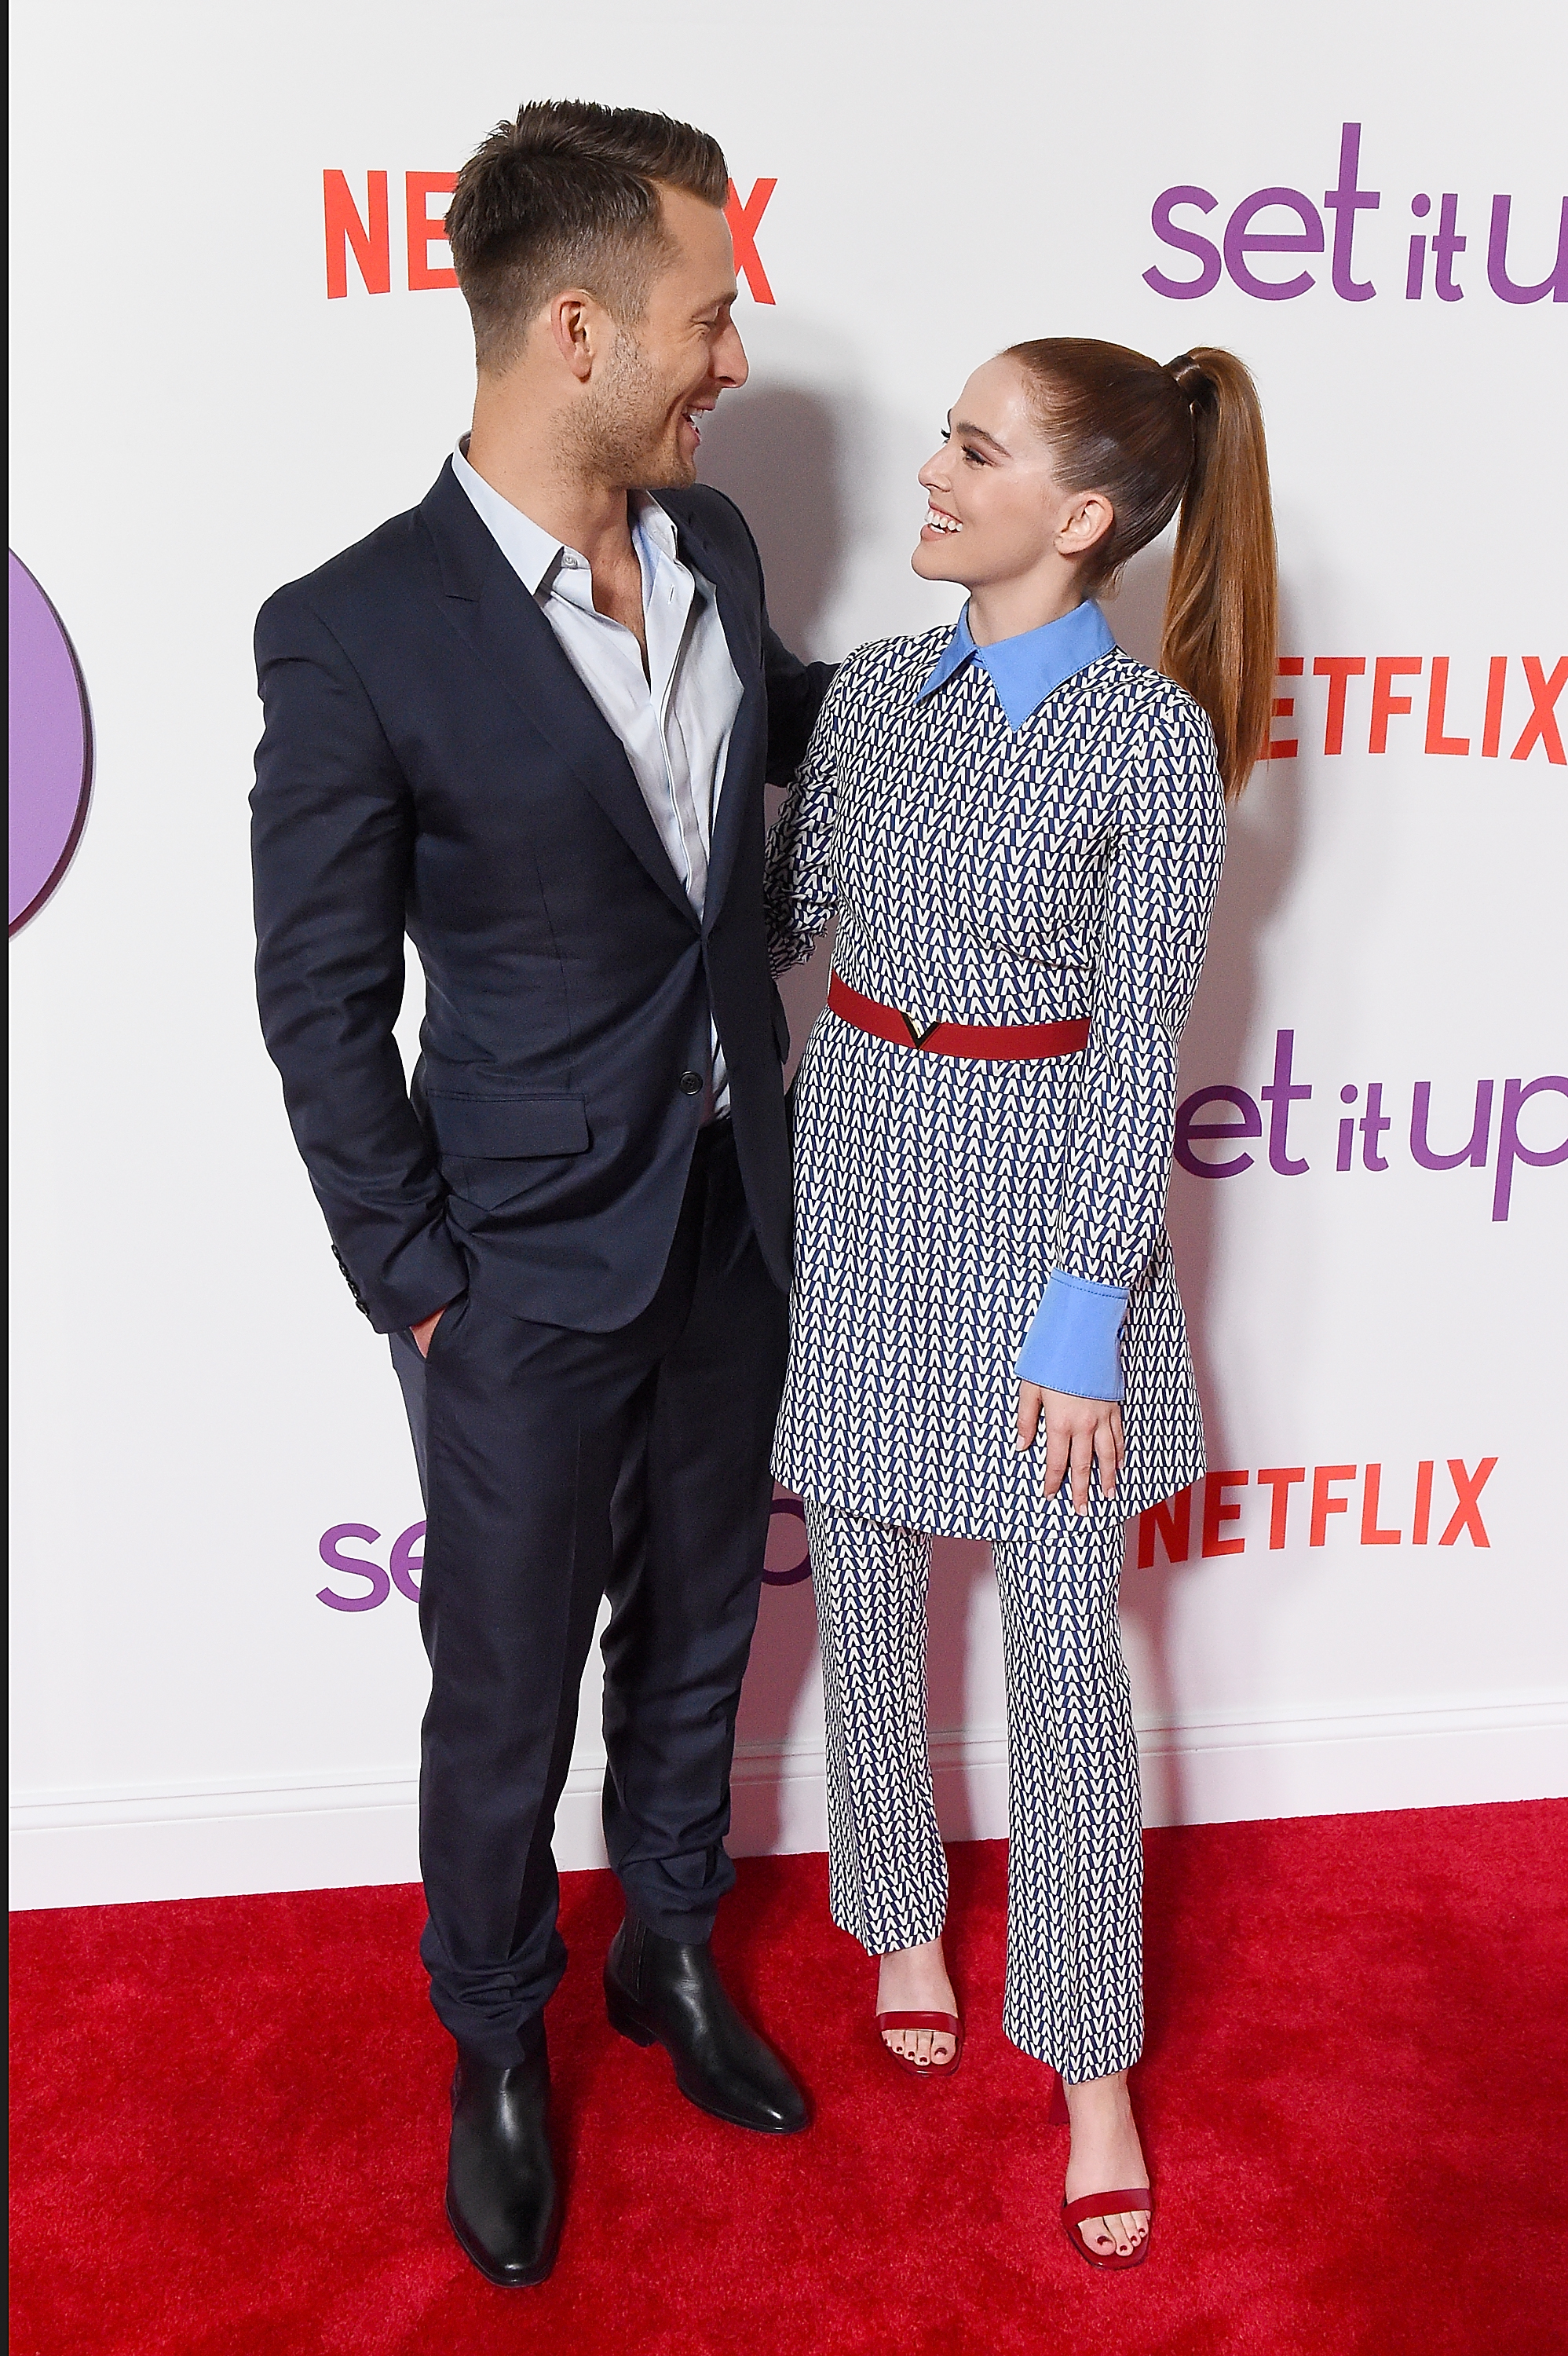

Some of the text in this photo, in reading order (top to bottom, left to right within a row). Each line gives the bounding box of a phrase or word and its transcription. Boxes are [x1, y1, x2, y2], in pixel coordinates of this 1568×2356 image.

[1142, 123, 1568, 305] set it u
[1255, 657, 1568, 765] ETFLIX
[1174, 1030, 1568, 1222] et it up
[1138, 1458, 1498, 1569] NETFLIX
